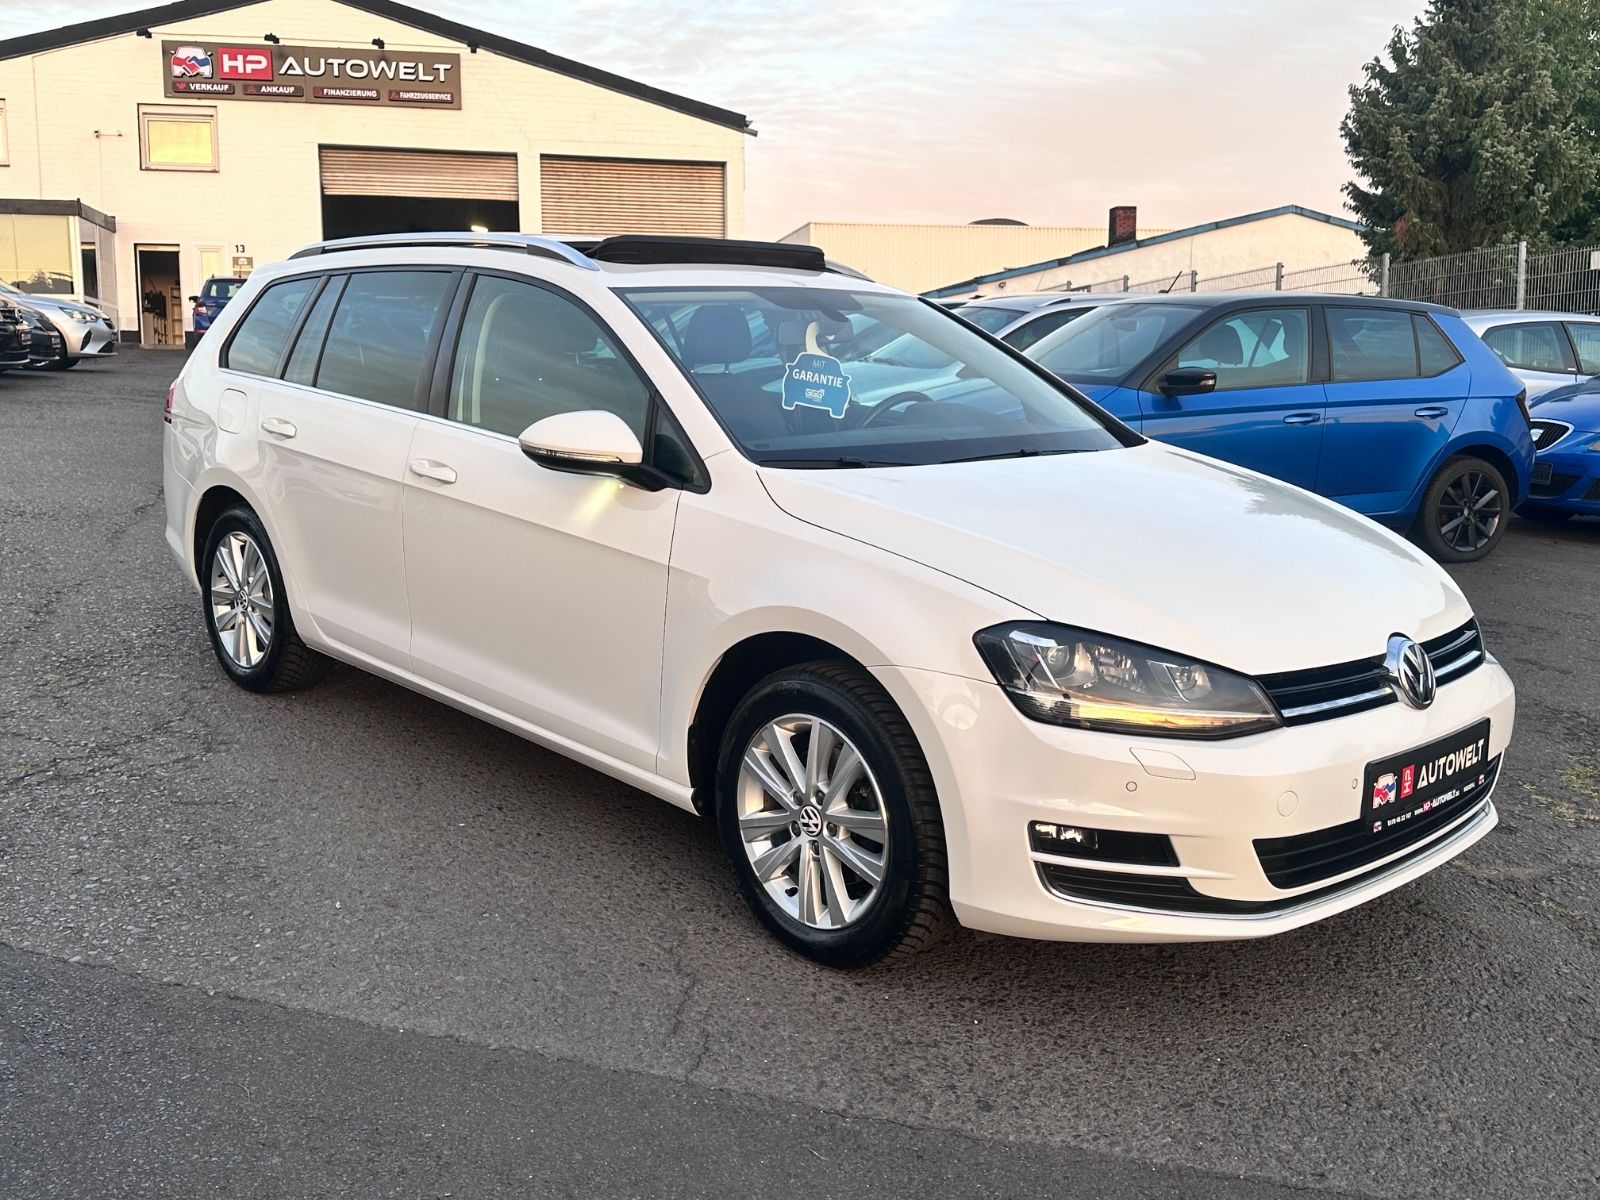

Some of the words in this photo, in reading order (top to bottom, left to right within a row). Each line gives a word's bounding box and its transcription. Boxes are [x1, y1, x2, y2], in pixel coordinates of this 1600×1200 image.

[222, 54, 268, 74] HP
[278, 56, 452, 82] AUTOWELT
[189, 83, 229, 92] VERKAUF
[260, 85, 295, 94] ANKAUF
[323, 88, 378, 98] FINANZIERUNG
[399, 91, 452, 101] FAHRZEUGSERVICE
[235, 244, 245, 254] 13
[812, 359, 826, 369] MIT
[792, 369, 843, 388] GARANTIE
[1417, 738, 1485, 790] AUTOWELT
